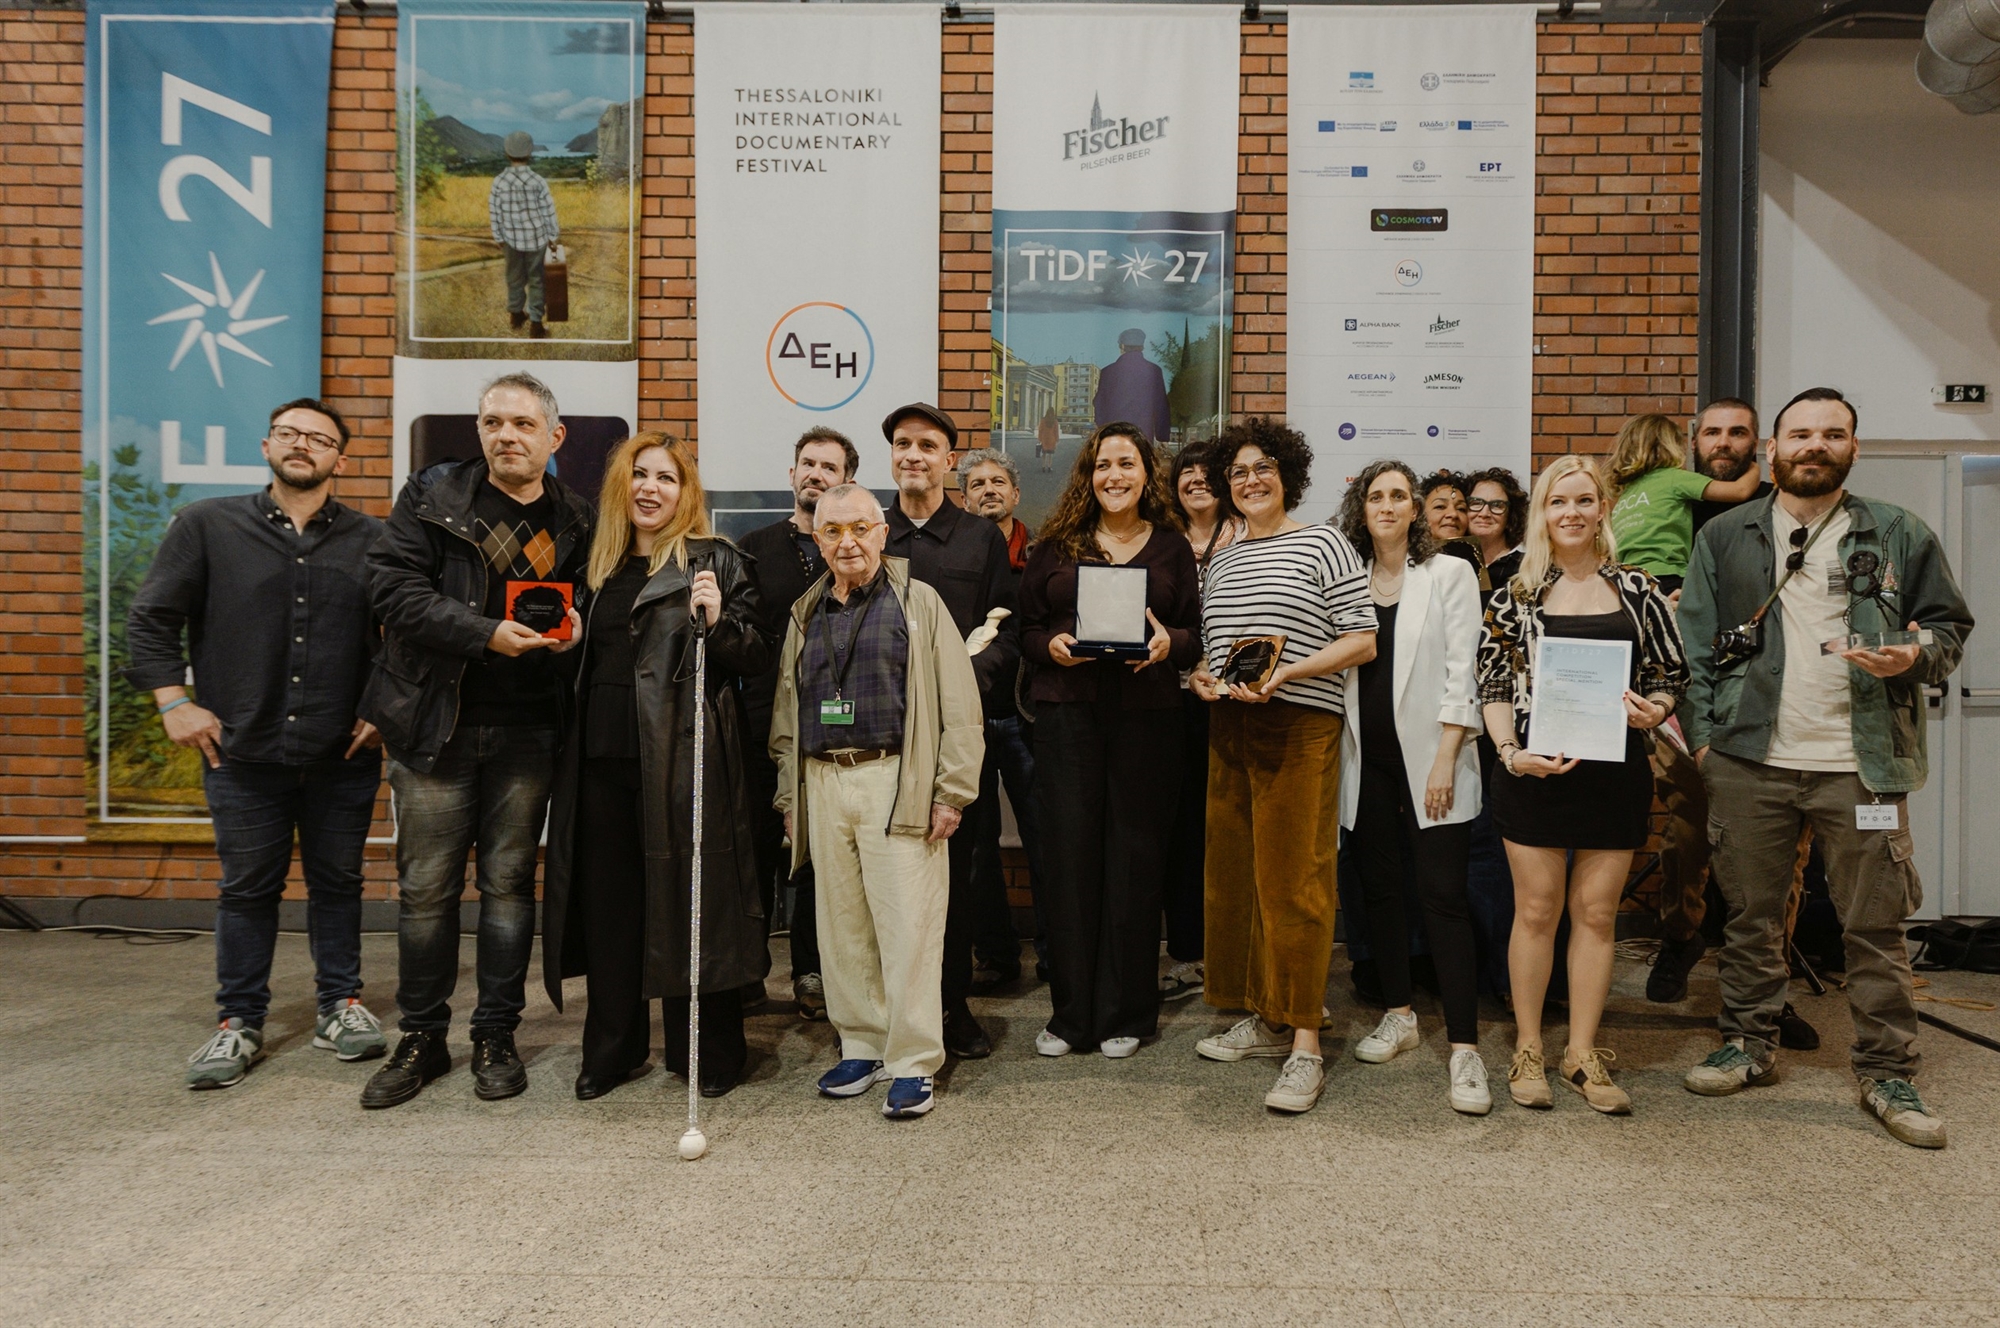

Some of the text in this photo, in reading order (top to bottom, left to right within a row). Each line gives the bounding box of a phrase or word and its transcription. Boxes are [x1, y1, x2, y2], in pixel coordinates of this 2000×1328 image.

[735, 88, 882, 103] THESSALONIKI
[735, 112, 902, 127] INTERNATIONAL
[736, 135, 891, 150] DOCUMENTARY
[1062, 115, 1170, 162] Fischer
[158, 71, 272, 229] 27
[736, 159, 827, 173] FESTIVAL
[1080, 147, 1151, 171] PILSENER BEER
[1020, 250, 1209, 284] TiDF 27
[1398, 266, 1419, 279] ΔΕΗ
[1429, 318, 1461, 333] Fischer
[778, 332, 857, 379] ΔΕΗ
[1423, 373, 1463, 384] JAMESON
[1556, 668, 1598, 676] INTERNATIONAL
